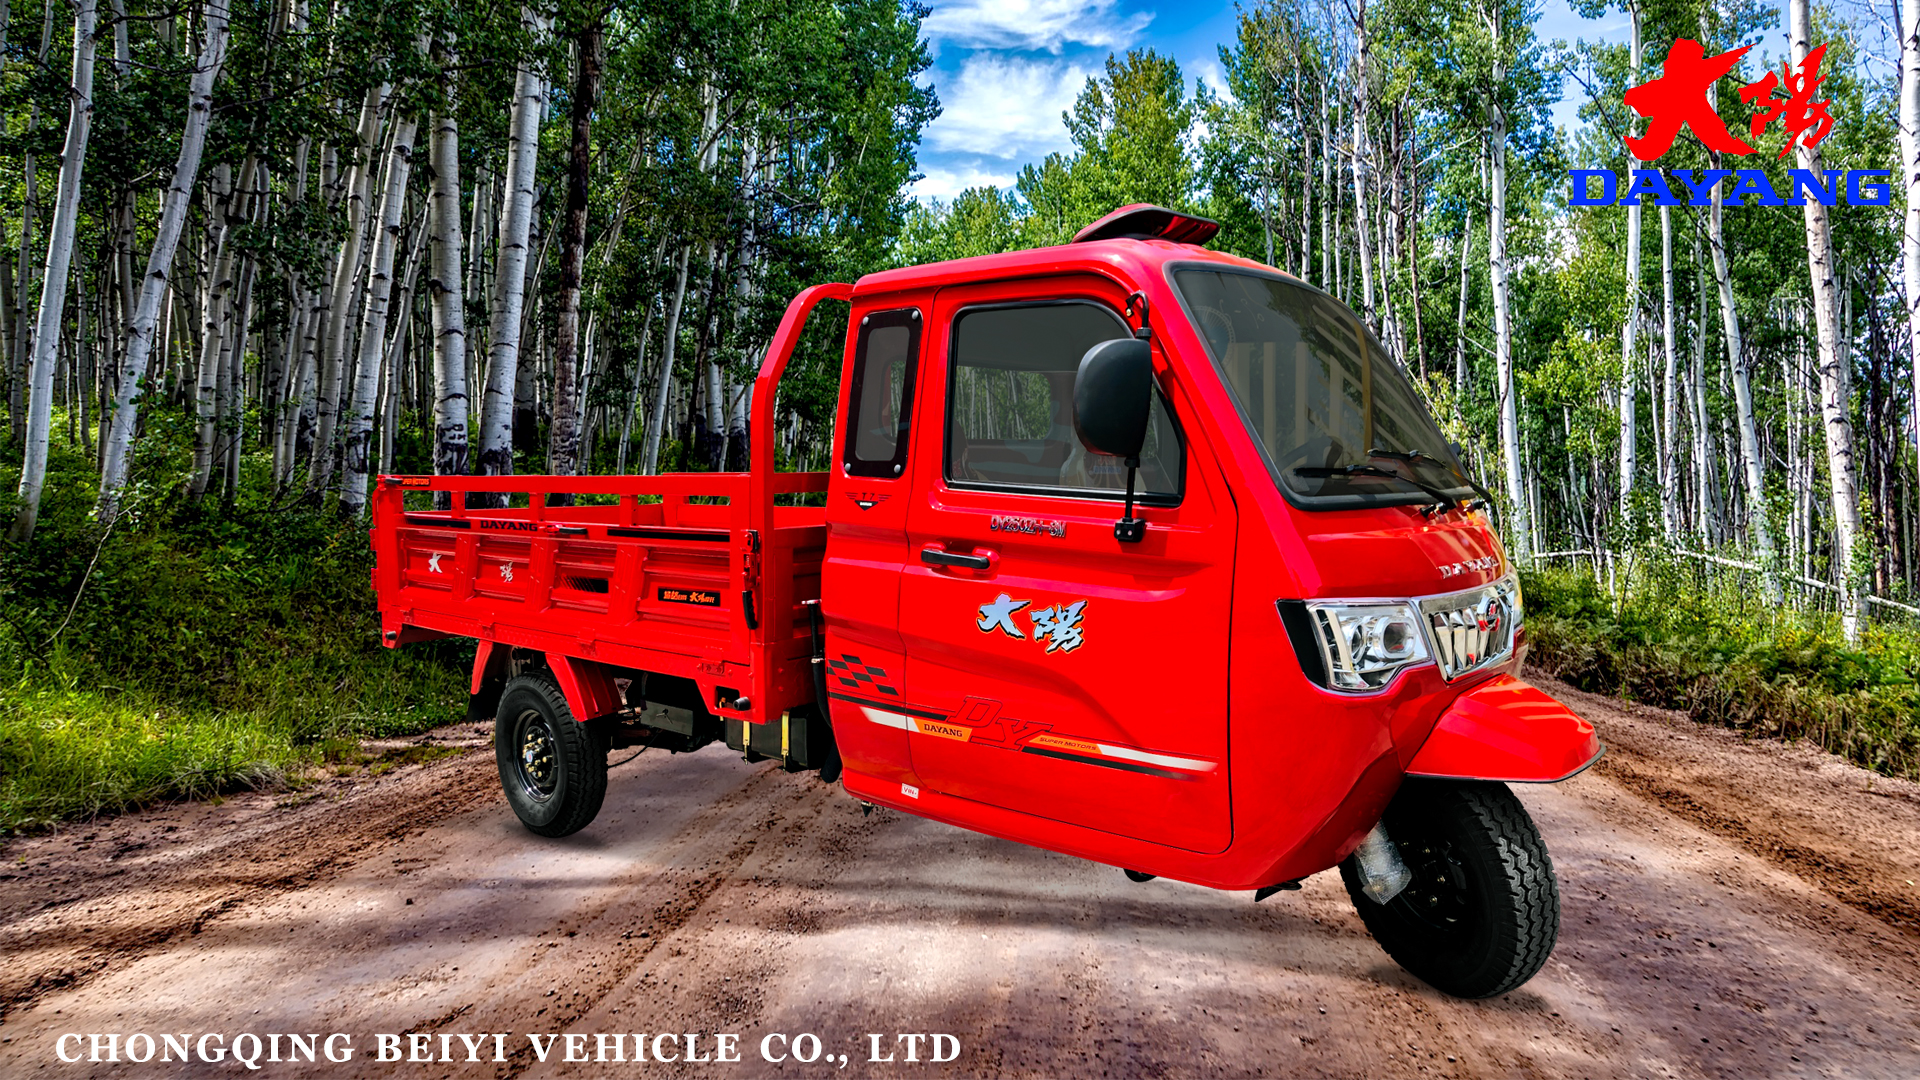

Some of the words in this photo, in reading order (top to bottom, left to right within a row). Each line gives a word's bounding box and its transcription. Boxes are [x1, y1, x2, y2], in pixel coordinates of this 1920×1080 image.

[480, 520, 538, 532] DAYANG
[923, 723, 963, 738] DAYANG
[1039, 737, 1064, 746] SUPER
[1064, 741, 1097, 751] MOTORS
